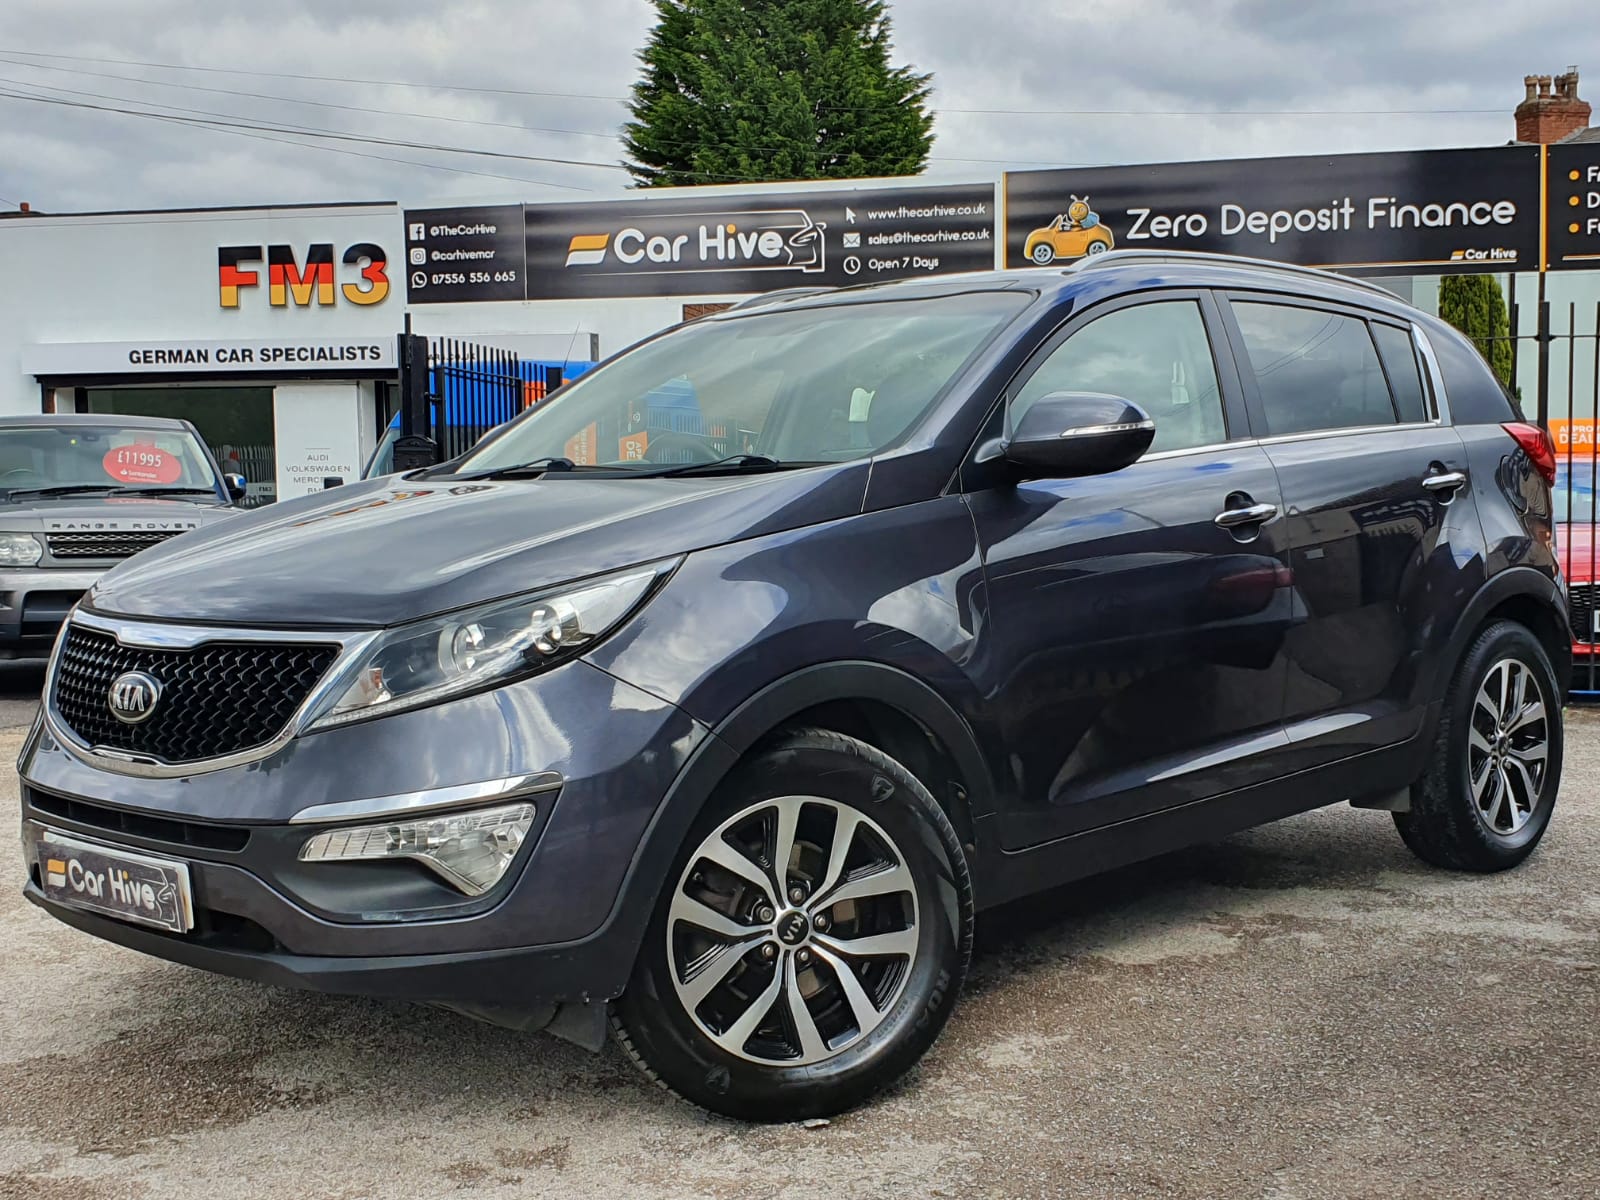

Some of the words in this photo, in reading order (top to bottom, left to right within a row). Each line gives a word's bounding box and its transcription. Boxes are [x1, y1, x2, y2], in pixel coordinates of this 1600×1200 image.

[868, 203, 986, 220] www.thecarhive.co.uk
[1126, 208, 1207, 240] Zero
[1220, 197, 1354, 243] Deposit
[1367, 199, 1517, 230] Finance
[430, 224, 497, 237] @TheCarHive
[868, 230, 990, 245] sales@thecarhive.co.uk
[613, 228, 688, 264] Car
[698, 223, 784, 261] Hive
[431, 249, 496, 262] @carhivemcr
[1465, 248, 1489, 260] Car
[1490, 247, 1517, 259] Hive
[868, 258, 900, 272] Open
[902, 258, 910, 269] 7
[913, 257, 939, 270] Days
[218, 243, 390, 308] FM3
[432, 273, 466, 285] 07556
[469, 272, 491, 284] 556
[494, 271, 516, 283] 665
[128, 348, 209, 365] GERMAN
[215, 347, 254, 364] CAR
[260, 345, 382, 363] SPECIALISTS
[117, 450, 162, 468] £11995
[307, 454, 329, 462] AUDI
[285, 465, 351, 473] VOLKSWAGEN
[68, 859, 105, 898] Car
[108, 866, 155, 910] Hive
